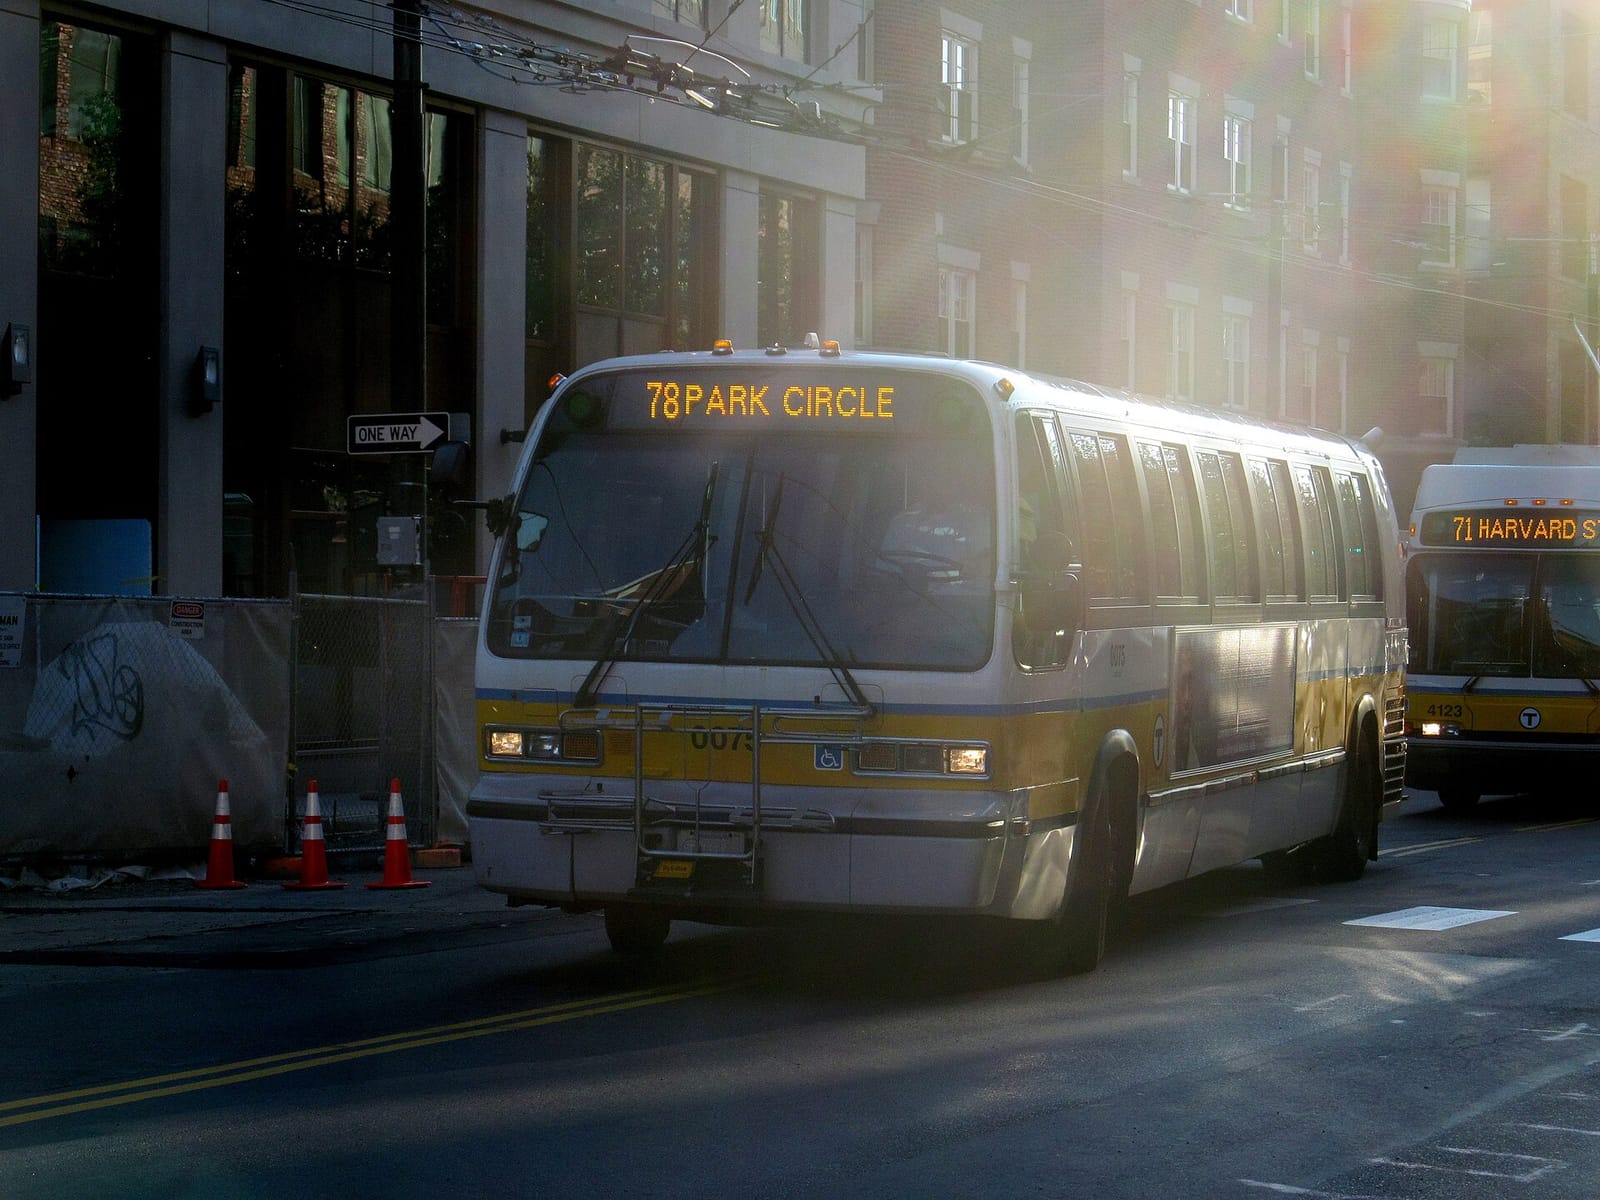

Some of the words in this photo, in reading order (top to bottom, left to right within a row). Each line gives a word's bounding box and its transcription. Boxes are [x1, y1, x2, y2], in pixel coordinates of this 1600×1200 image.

[783, 386, 894, 417] CIRCLE
[358, 427, 385, 442] ONE
[390, 426, 417, 441] WAY
[1453, 516, 1473, 541] 71
[1478, 518, 1577, 540] HARVARD
[1582, 519, 1600, 540] S
[176, 605, 200, 615] DANGER
[1427, 704, 1462, 717] 4123
